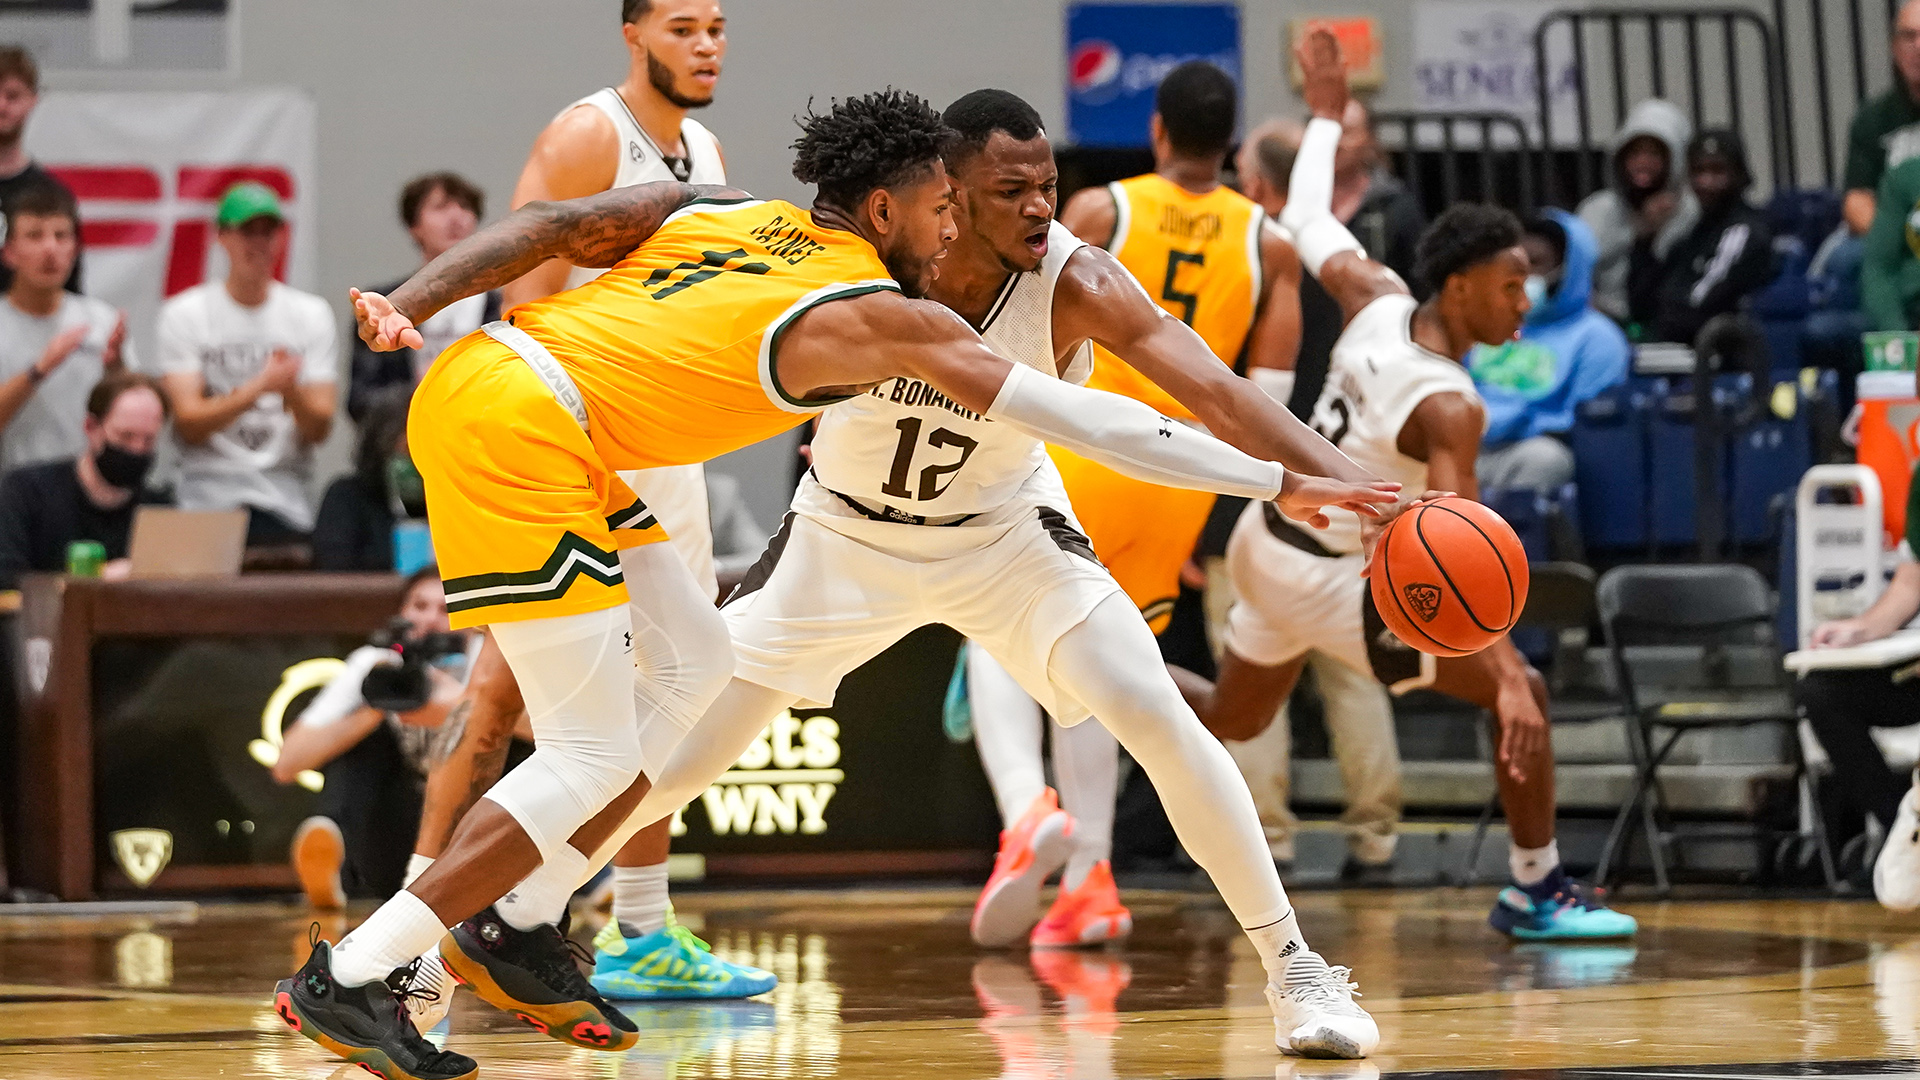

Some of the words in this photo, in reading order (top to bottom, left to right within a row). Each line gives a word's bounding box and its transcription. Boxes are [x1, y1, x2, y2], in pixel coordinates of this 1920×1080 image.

[642, 248, 772, 300] 11
[1162, 249, 1205, 327] 5
[881, 416, 979, 501] 12
[889, 511, 918, 524] adidas
[700, 783, 837, 835] WNY
